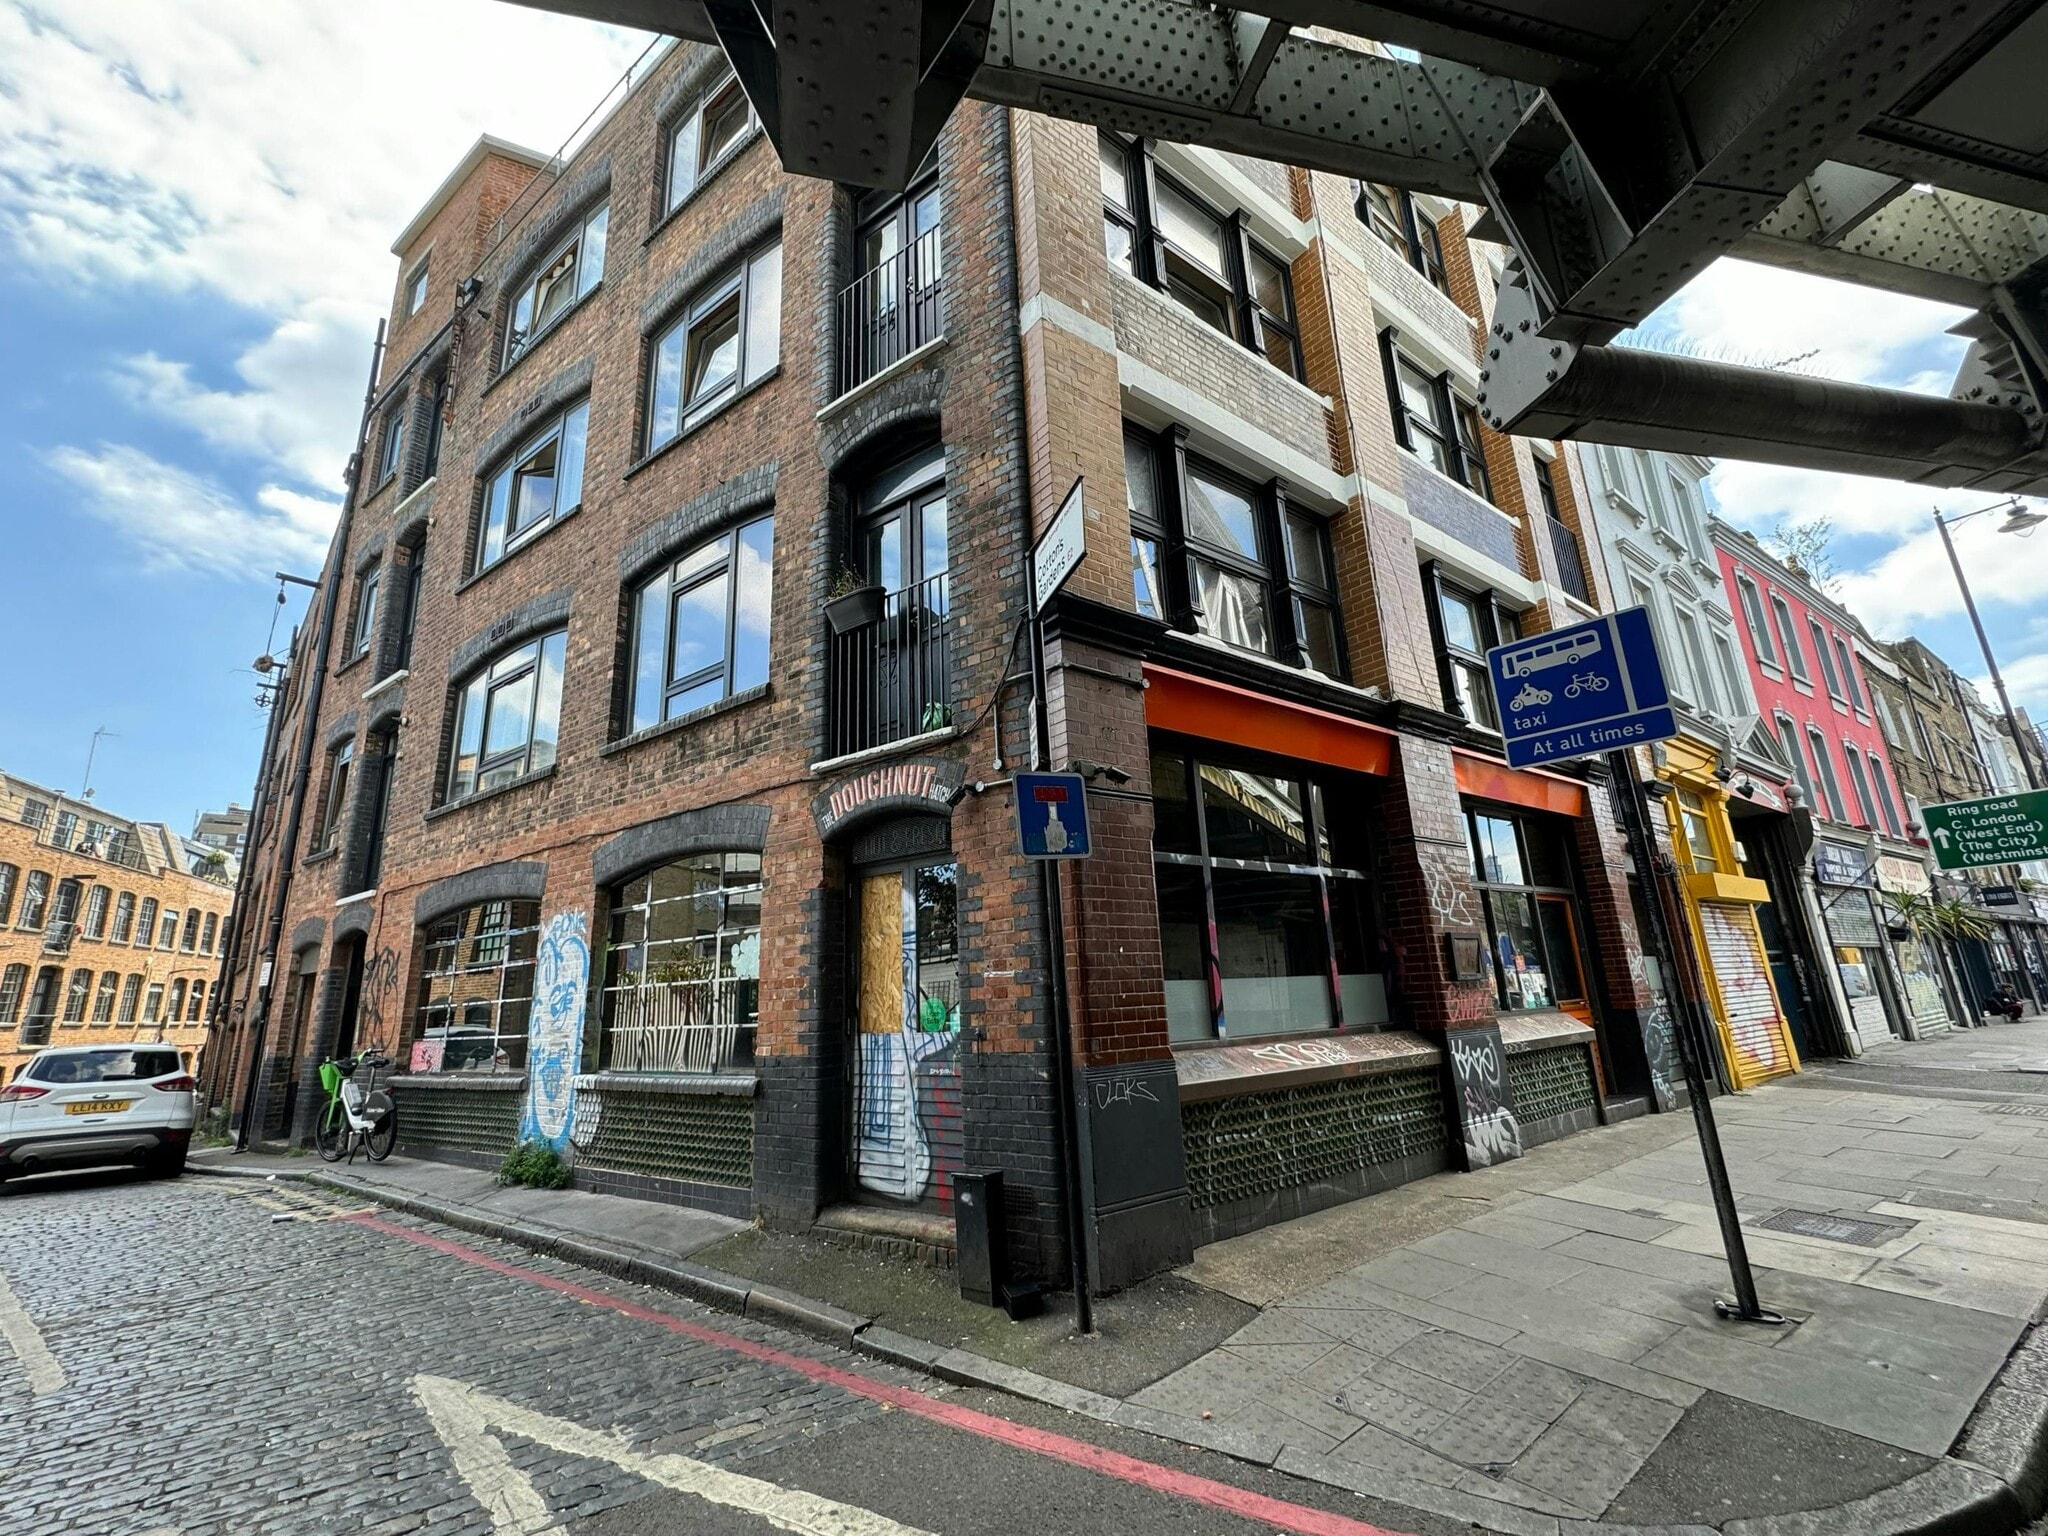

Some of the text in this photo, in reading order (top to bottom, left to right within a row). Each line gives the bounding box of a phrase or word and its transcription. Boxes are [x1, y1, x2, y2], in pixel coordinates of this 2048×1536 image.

[1038, 556, 1066, 601] Gardens
[1513, 712, 1547, 730] taxi
[1533, 722, 1645, 756] At all times
[821, 810, 836, 830] THE
[829, 765, 937, 821] DOUGHNUT
[1947, 798, 2018, 817] Ring road
[1951, 812, 2027, 830] C. London
[1955, 820, 2044, 842] (West End)
[1959, 833, 2038, 853] (The City)
[101, 1101, 124, 1111] KXY
